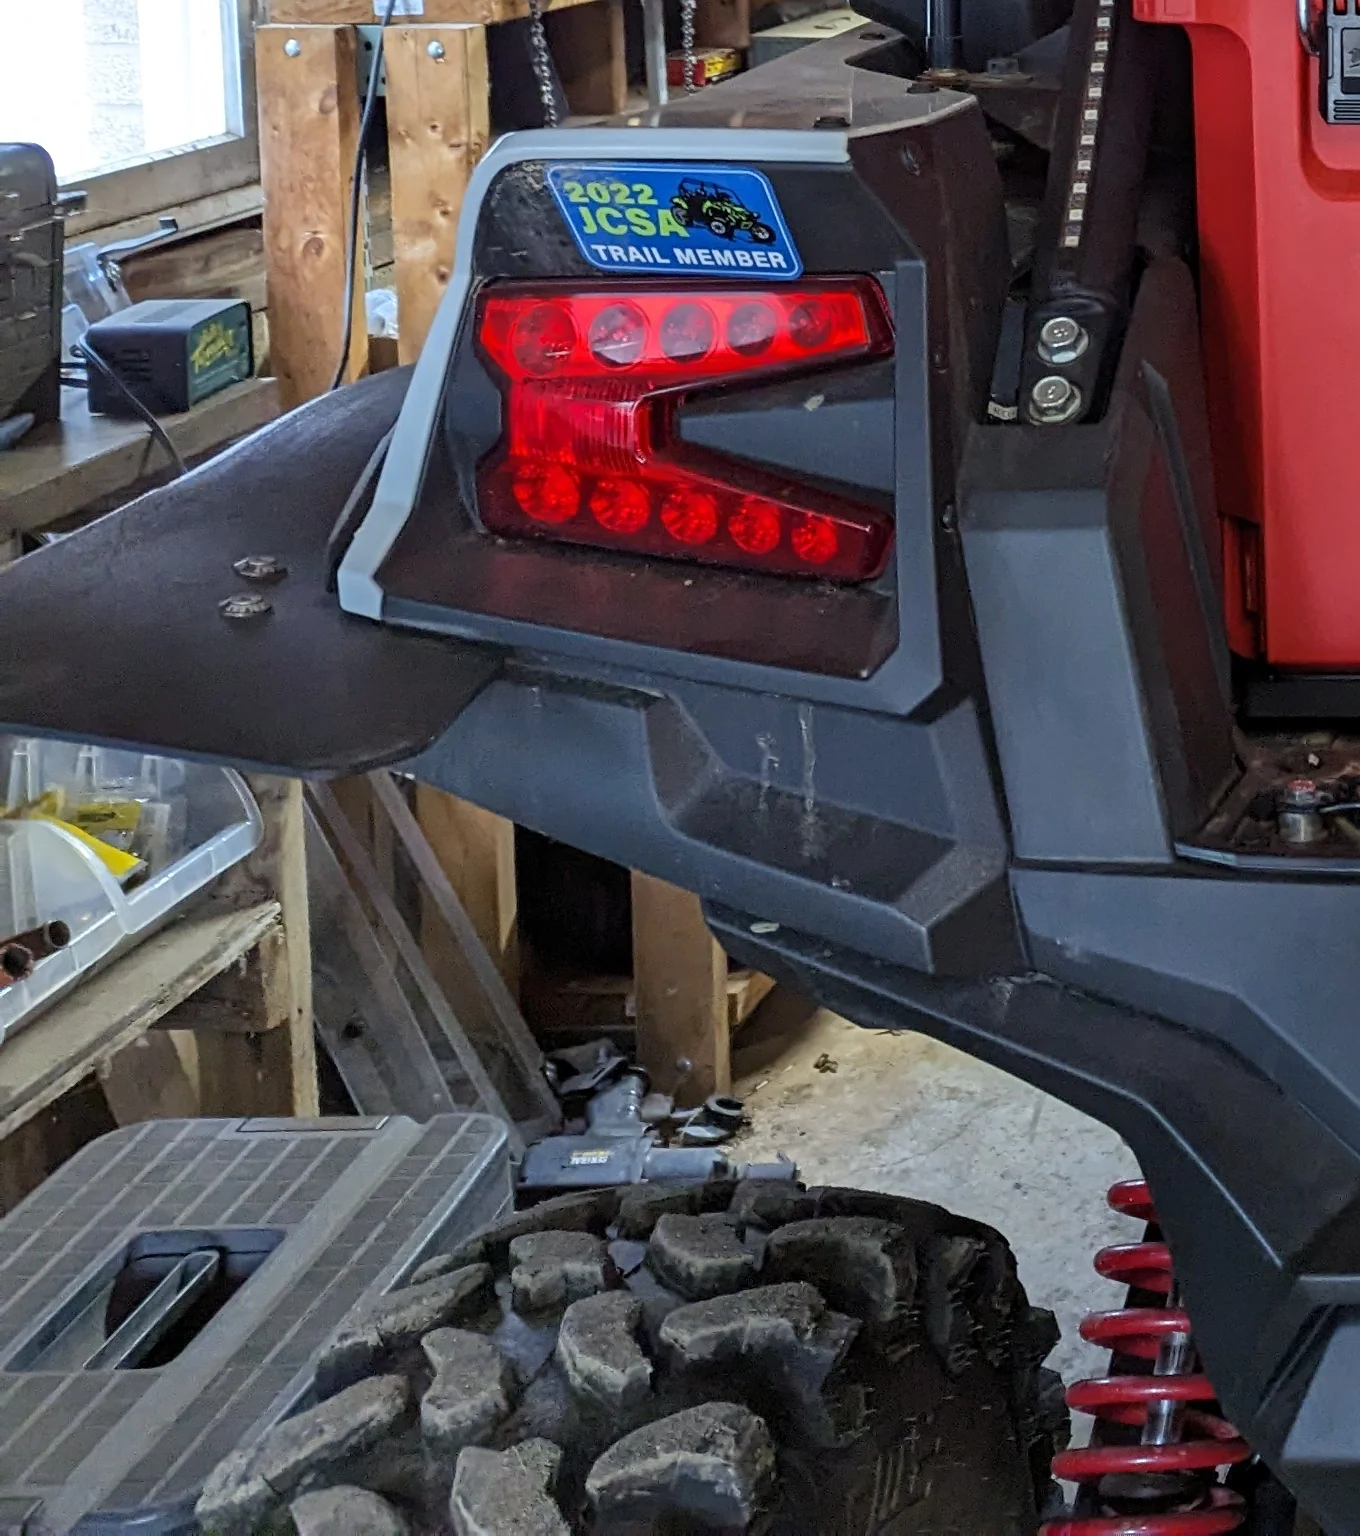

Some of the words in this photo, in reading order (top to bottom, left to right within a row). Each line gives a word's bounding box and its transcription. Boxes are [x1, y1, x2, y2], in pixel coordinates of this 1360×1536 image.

[563, 181, 658, 205] 2022
[578, 206, 690, 238] JCSA
[590, 244, 670, 264] TRAIL
[673, 248, 787, 268] MEMBER
